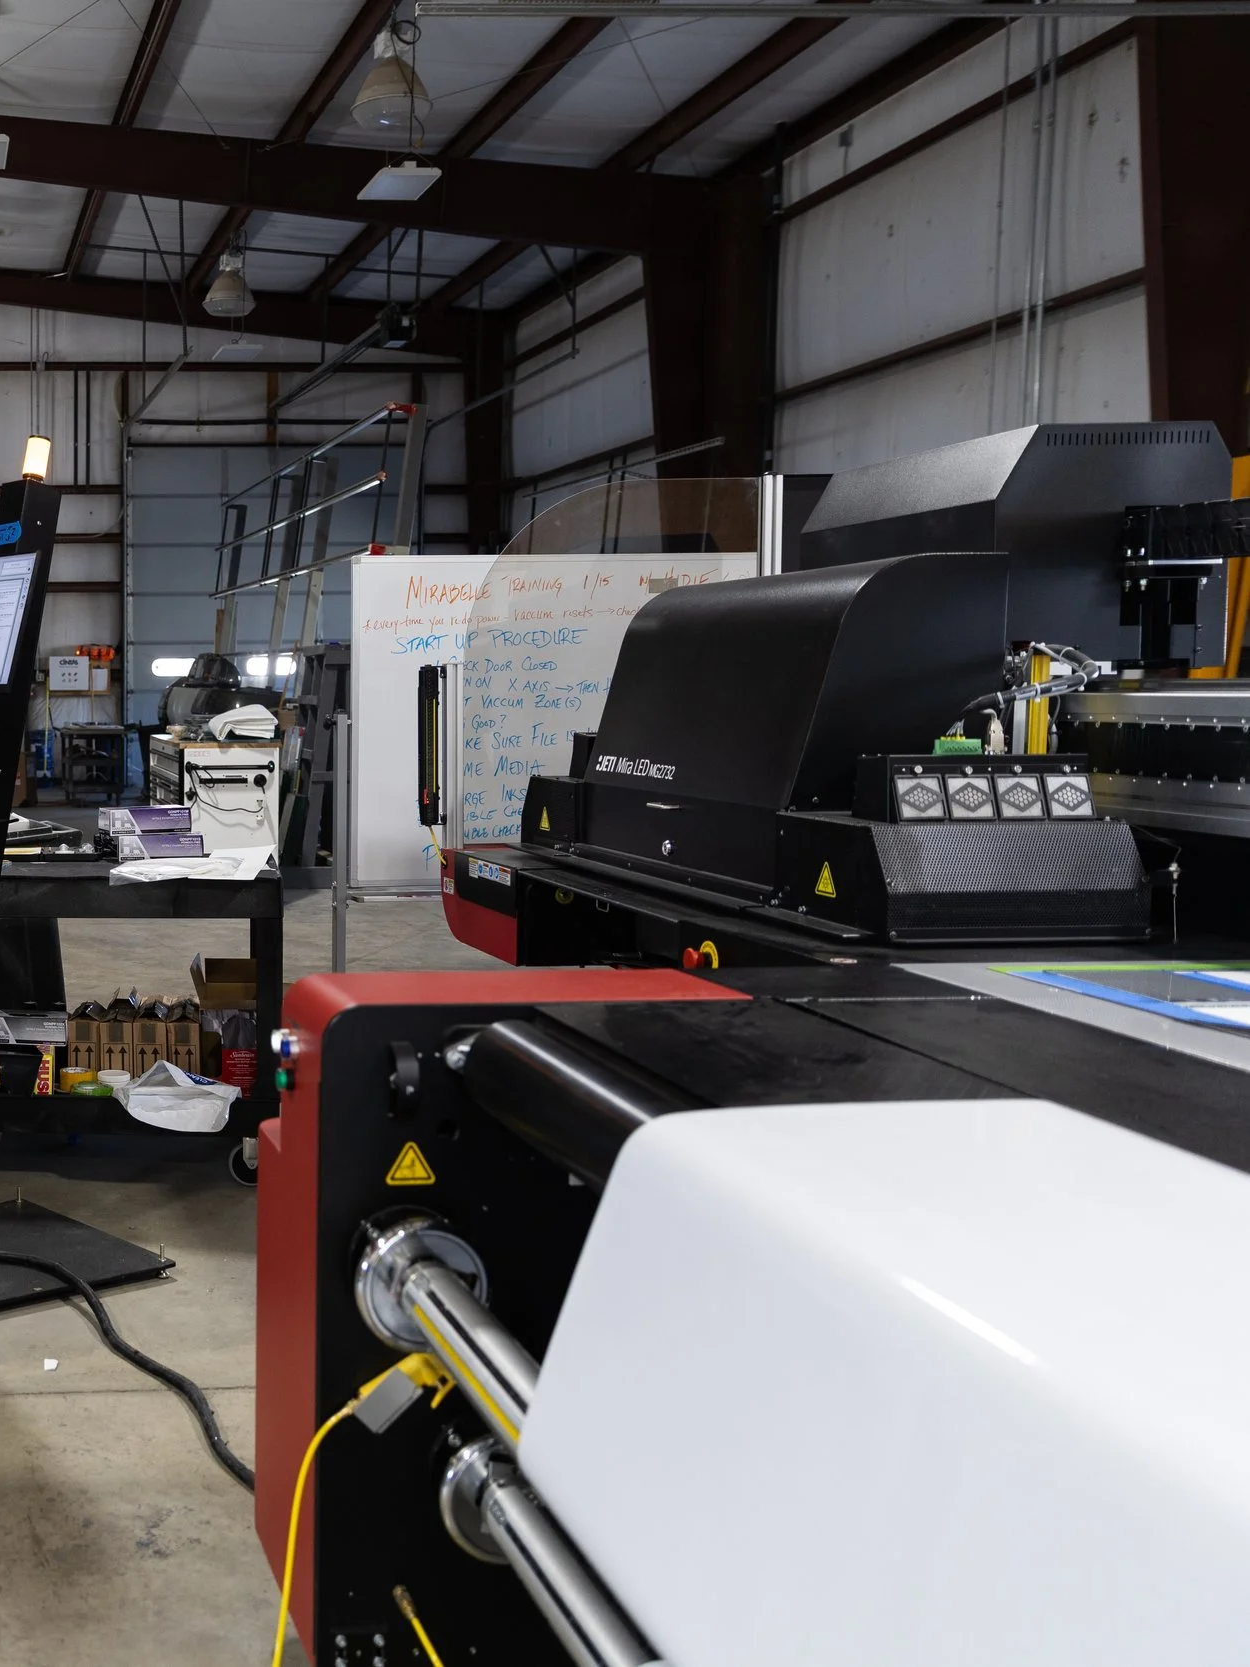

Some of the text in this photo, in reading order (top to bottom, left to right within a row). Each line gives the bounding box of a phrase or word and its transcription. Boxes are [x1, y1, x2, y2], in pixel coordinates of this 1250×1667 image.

[406, 576, 492, 609] MIRABELLE
[501, 575, 564, 598] TRAINING
[583, 573, 614, 600] 1/15
[429, 616, 444, 633] you
[391, 627, 588, 654] START UP PROCEDURE
[485, 659, 513, 674] DOOR
[522, 656, 557, 672] CLOSED
[508, 678, 518, 691] X
[523, 681, 550, 692] AXIS
[576, 680, 598, 694] THEN
[481, 695, 523, 709] VACCUM
[491, 732, 523, 749] SURE
[532, 722, 557, 747] FILE
[494, 755, 546, 777] MEDIA
[615, 757, 633, 774] Mira
[633, 759, 650, 776] LED
[648, 764, 675, 780] MG2732
[502, 784, 527, 802] INKS
